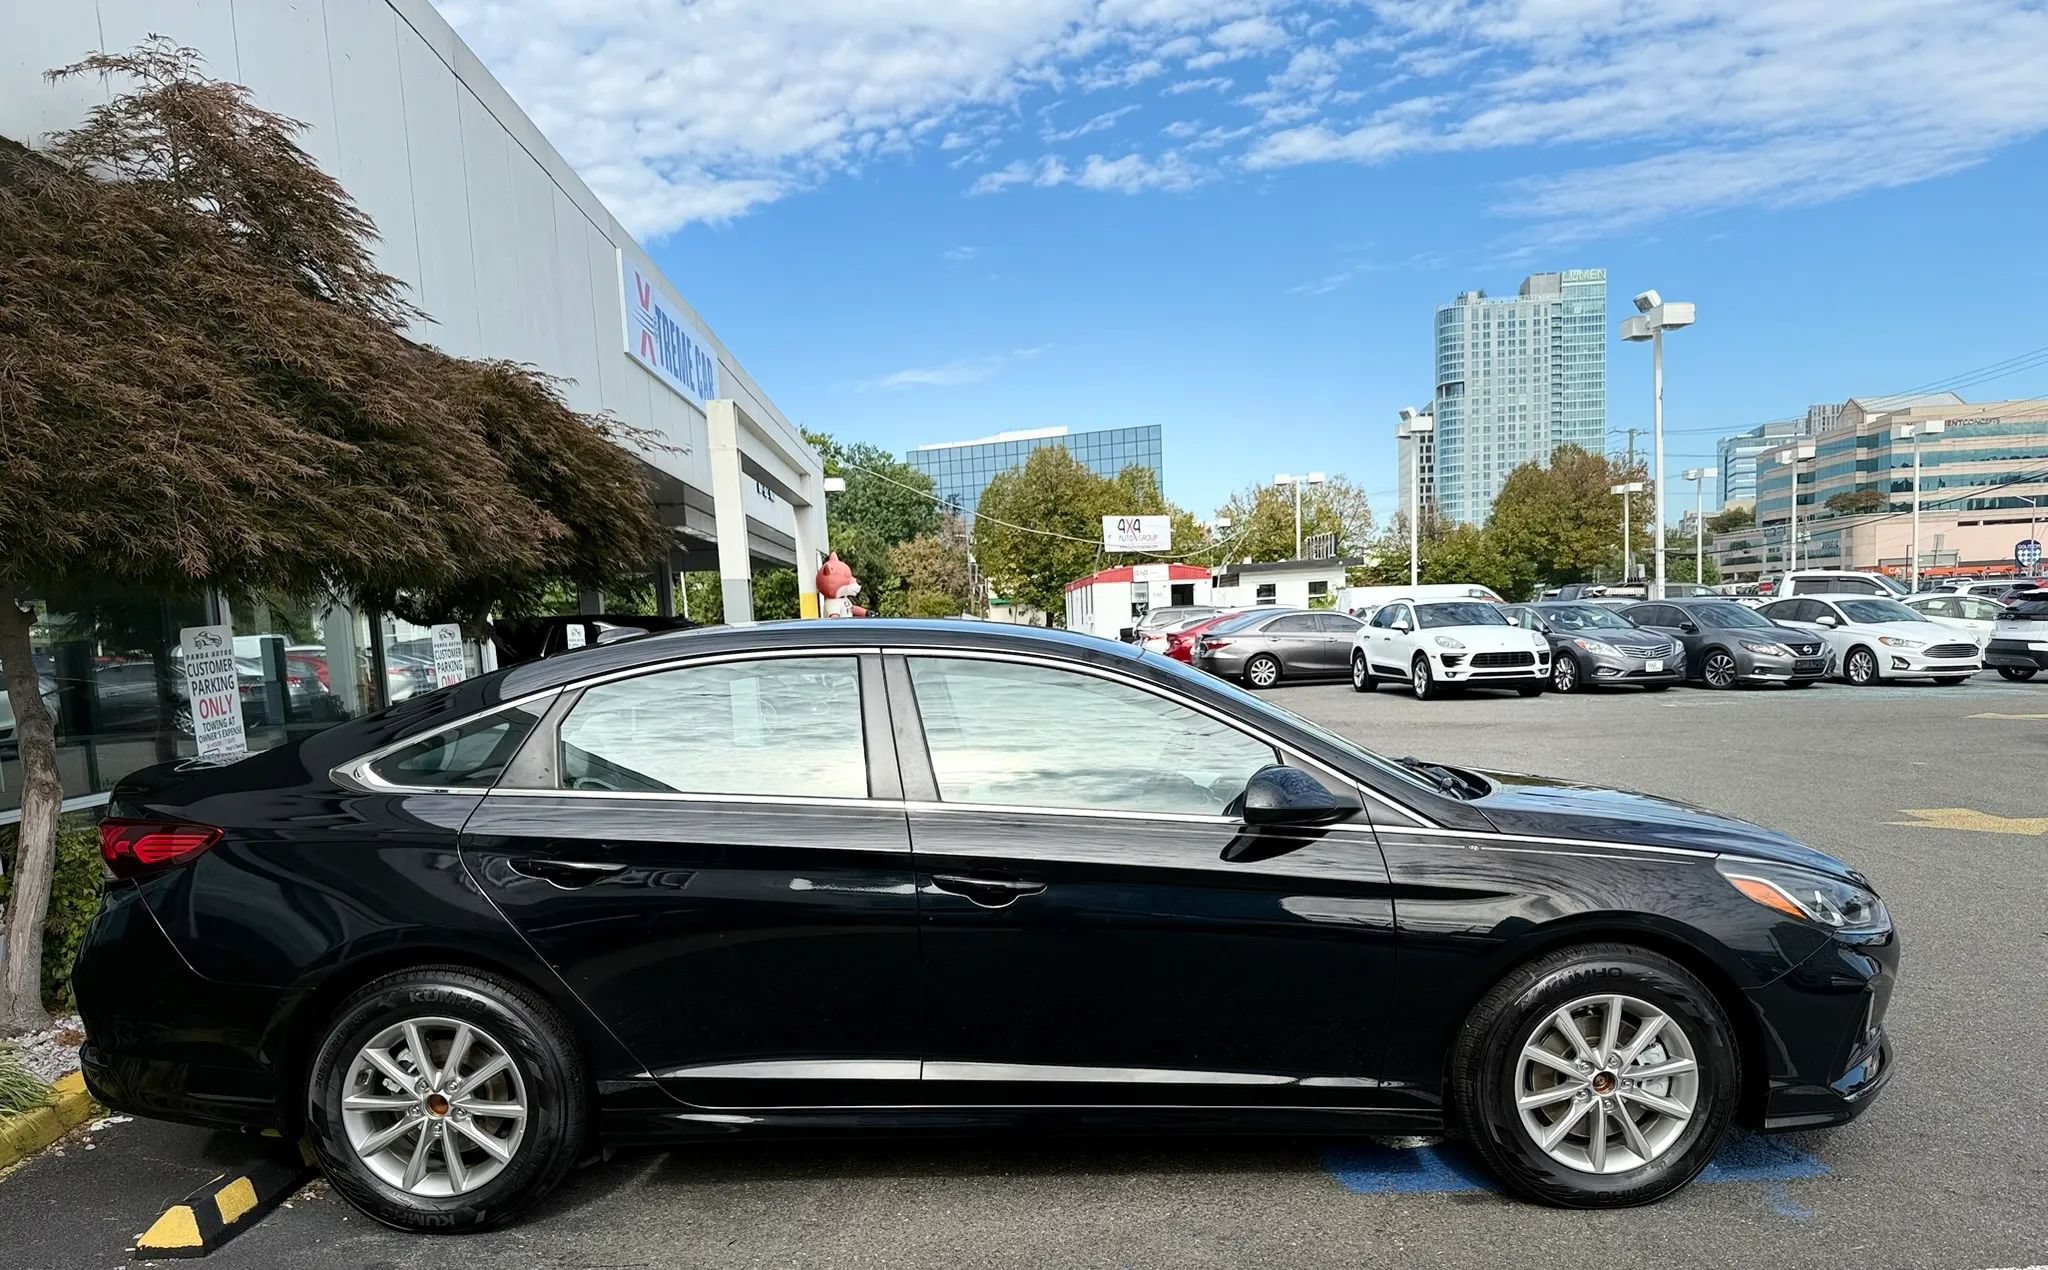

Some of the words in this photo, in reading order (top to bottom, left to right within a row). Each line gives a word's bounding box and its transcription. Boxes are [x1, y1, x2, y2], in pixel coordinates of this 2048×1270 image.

[1562, 269, 1607, 281] LUMEN
[695, 345, 715, 401] CAR
[185, 652, 209, 661] PANDA
[211, 649, 232, 657] AUTOS
[435, 648, 461, 660] CUSTOMER
[187, 658, 234, 677] CUSTOMER
[437, 659, 463, 673] PARKING
[191, 675, 235, 696] PARKING
[199, 694, 232, 719] ONLY
[202, 718, 228, 732] TOWING
[228, 716, 236, 728] AT
[198, 730, 222, 743] OWNER'S
[222, 726, 243, 738] EXPENSE
[408, 988, 487, 1014] KUMHO
